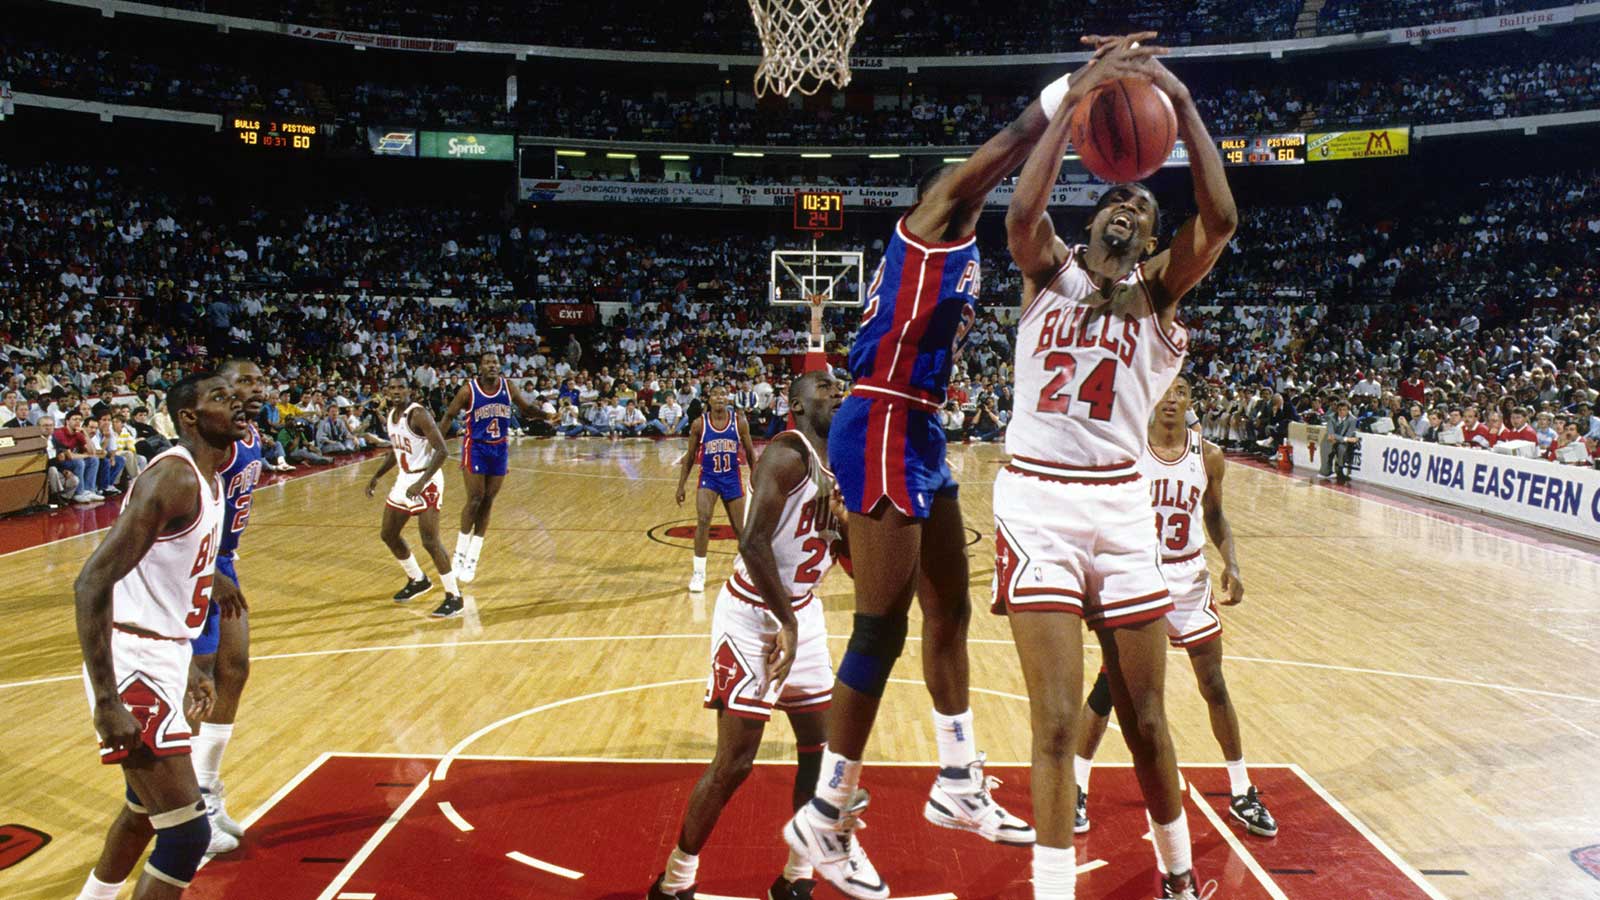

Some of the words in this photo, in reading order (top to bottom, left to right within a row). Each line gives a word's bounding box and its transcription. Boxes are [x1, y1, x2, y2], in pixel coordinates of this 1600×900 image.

[1405, 25, 1457, 39] Budweiser
[234, 119, 260, 130] BULLS
[282, 123, 316, 135] PISTONS
[240, 131, 257, 144] 49
[293, 135, 310, 149] 60
[448, 137, 486, 158] Sprite
[1222, 140, 1245, 149] BULLS
[1267, 137, 1301, 147] PISTONS
[1227, 151, 1243, 163] 49
[1278, 149, 1295, 161] 60
[582, 185, 628, 194] CHICAGO'S
[631, 187, 669, 196] WINNERS
[736, 187, 757, 195] The
[859, 189, 899, 198] Lineup
[803, 194, 840, 211] 10:37
[809, 212, 828, 226] 24
[559, 310, 583, 320] EXIT
[1032, 305, 1141, 369] BULLS
[1036, 351, 1118, 422] 24
[474, 403, 511, 422] PISTONS
[486, 418, 501, 439] 4
[713, 454, 731, 473] 11
[1381, 446, 1422, 480] 1989
[1426, 454, 1464, 491] NBA
[1471, 466, 1584, 517] EASTERN
[1149, 478, 1201, 516] ULLS
[184, 574, 215, 629] 5
